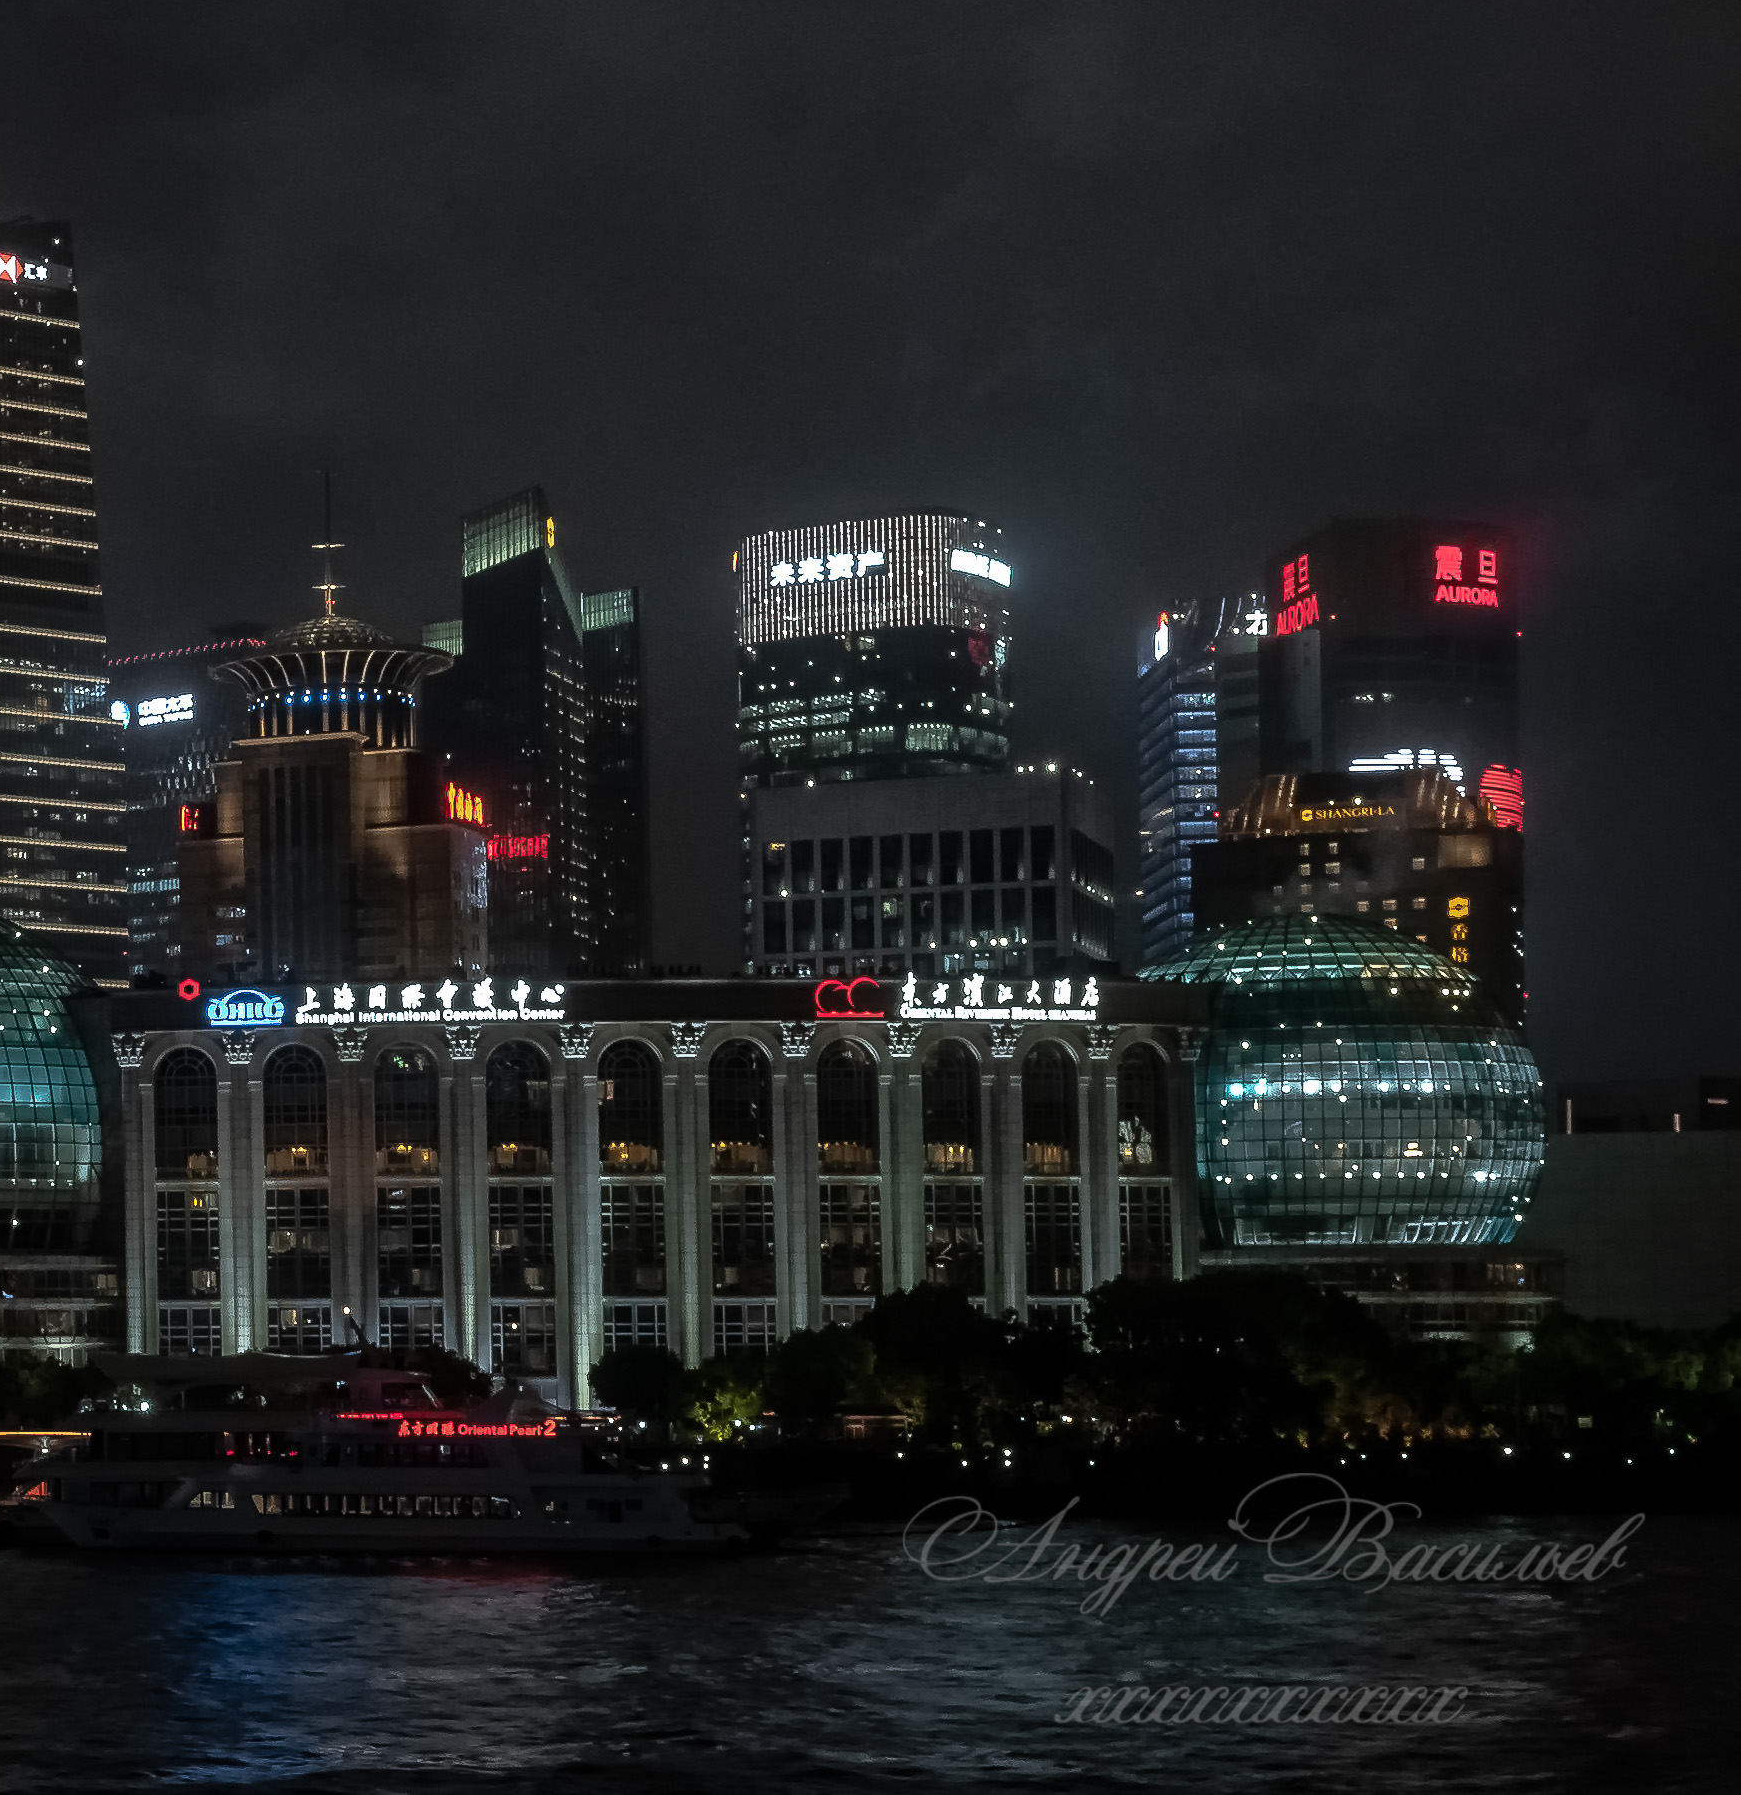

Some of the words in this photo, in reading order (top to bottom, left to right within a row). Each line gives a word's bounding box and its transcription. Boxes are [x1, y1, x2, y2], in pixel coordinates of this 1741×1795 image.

[1435, 584, 1499, 607] AURORA
[1276, 592, 1319, 636] AURORA
[295, 1011, 355, 1026] Shanghai
[358, 1009, 441, 1024] International
[442, 1008, 518, 1022] Convention
[519, 1007, 566, 1021] Center
[457, 1423, 508, 1436] Oriental
[509, 1423, 542, 1436] Pearl
[543, 1419, 557, 1437] 2
